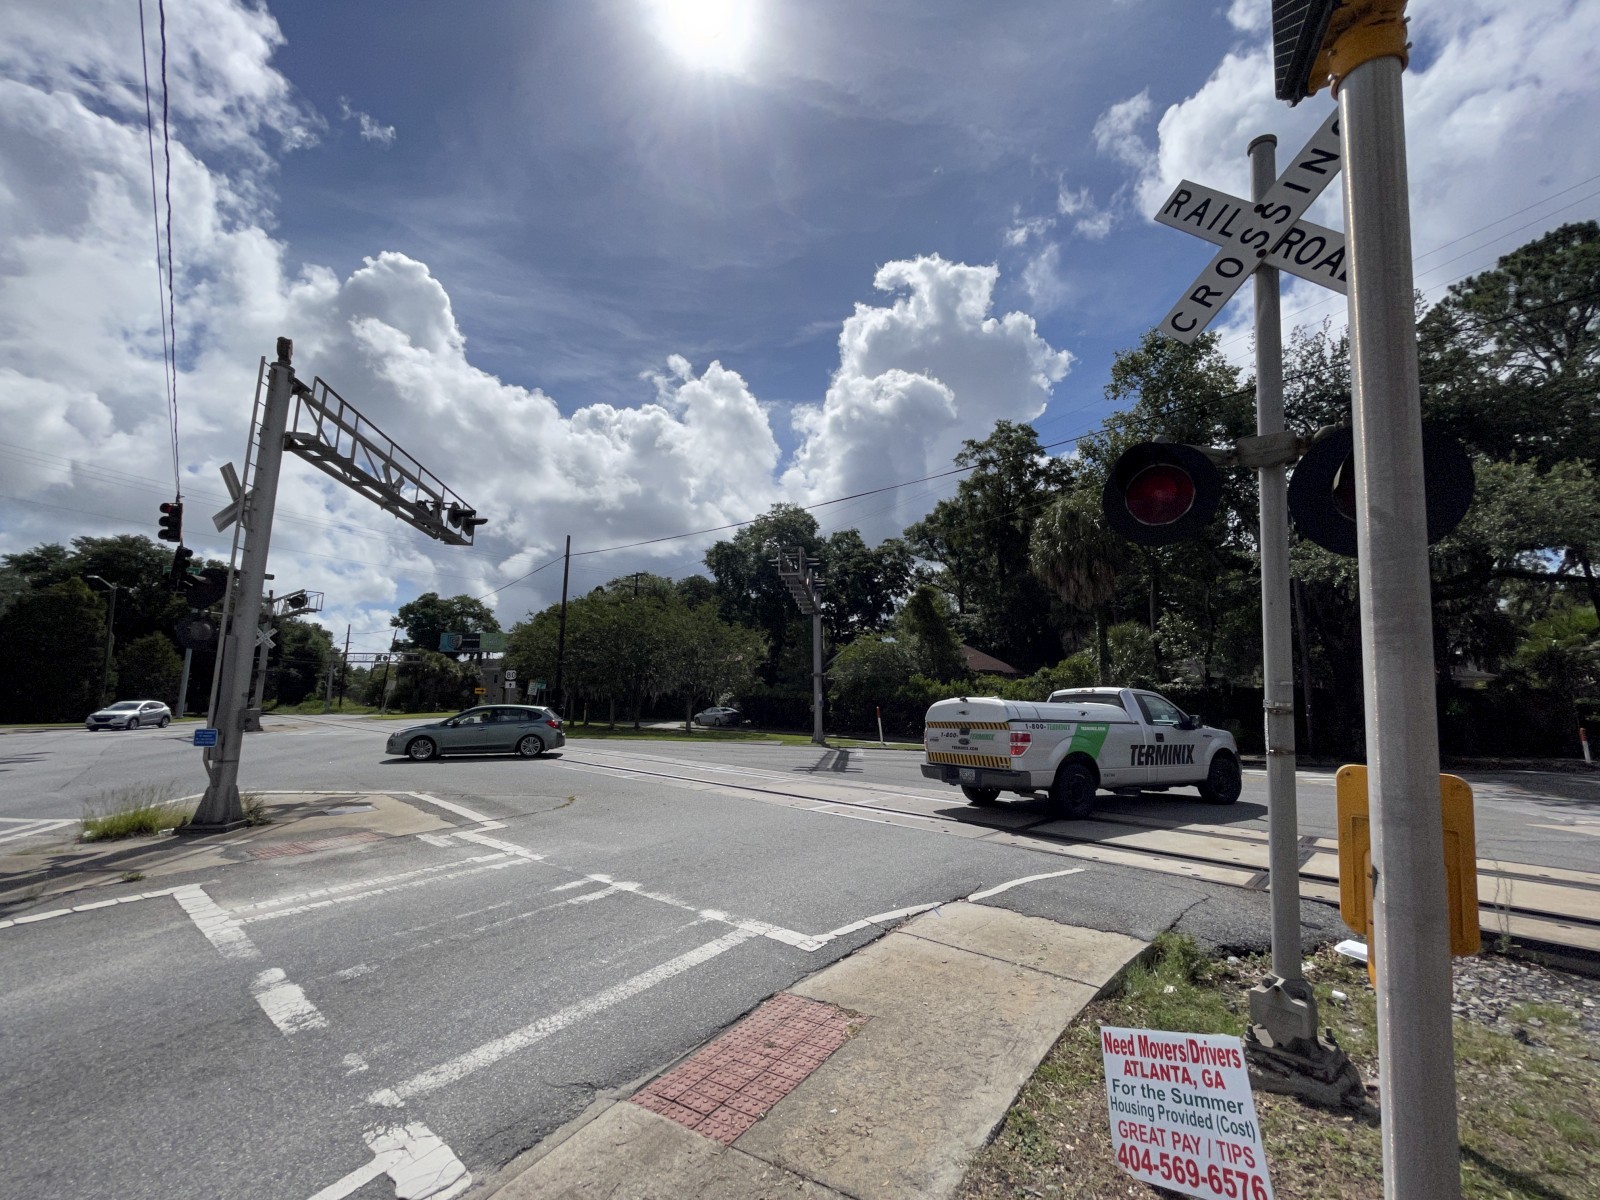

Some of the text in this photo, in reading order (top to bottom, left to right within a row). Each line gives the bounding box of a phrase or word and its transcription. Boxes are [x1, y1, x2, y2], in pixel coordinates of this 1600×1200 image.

[1164, 189, 1347, 282] RAIL ROA
[1130, 744, 1195, 766] TERMINIX
[1103, 1031, 1135, 1057] Need
[1124, 1059, 1226, 1090] ATLANTA, GA
[1112, 1078, 1244, 1115] For the Summer
[1110, 1095, 1256, 1143] Housing Provided (Cost)
[1118, 1120, 1166, 1147] GREAT
[1171, 1130, 1201, 1156] PAY
[1215, 1140, 1256, 1169] TIPS
[1117, 1143, 1268, 1200] 404-569-6576
